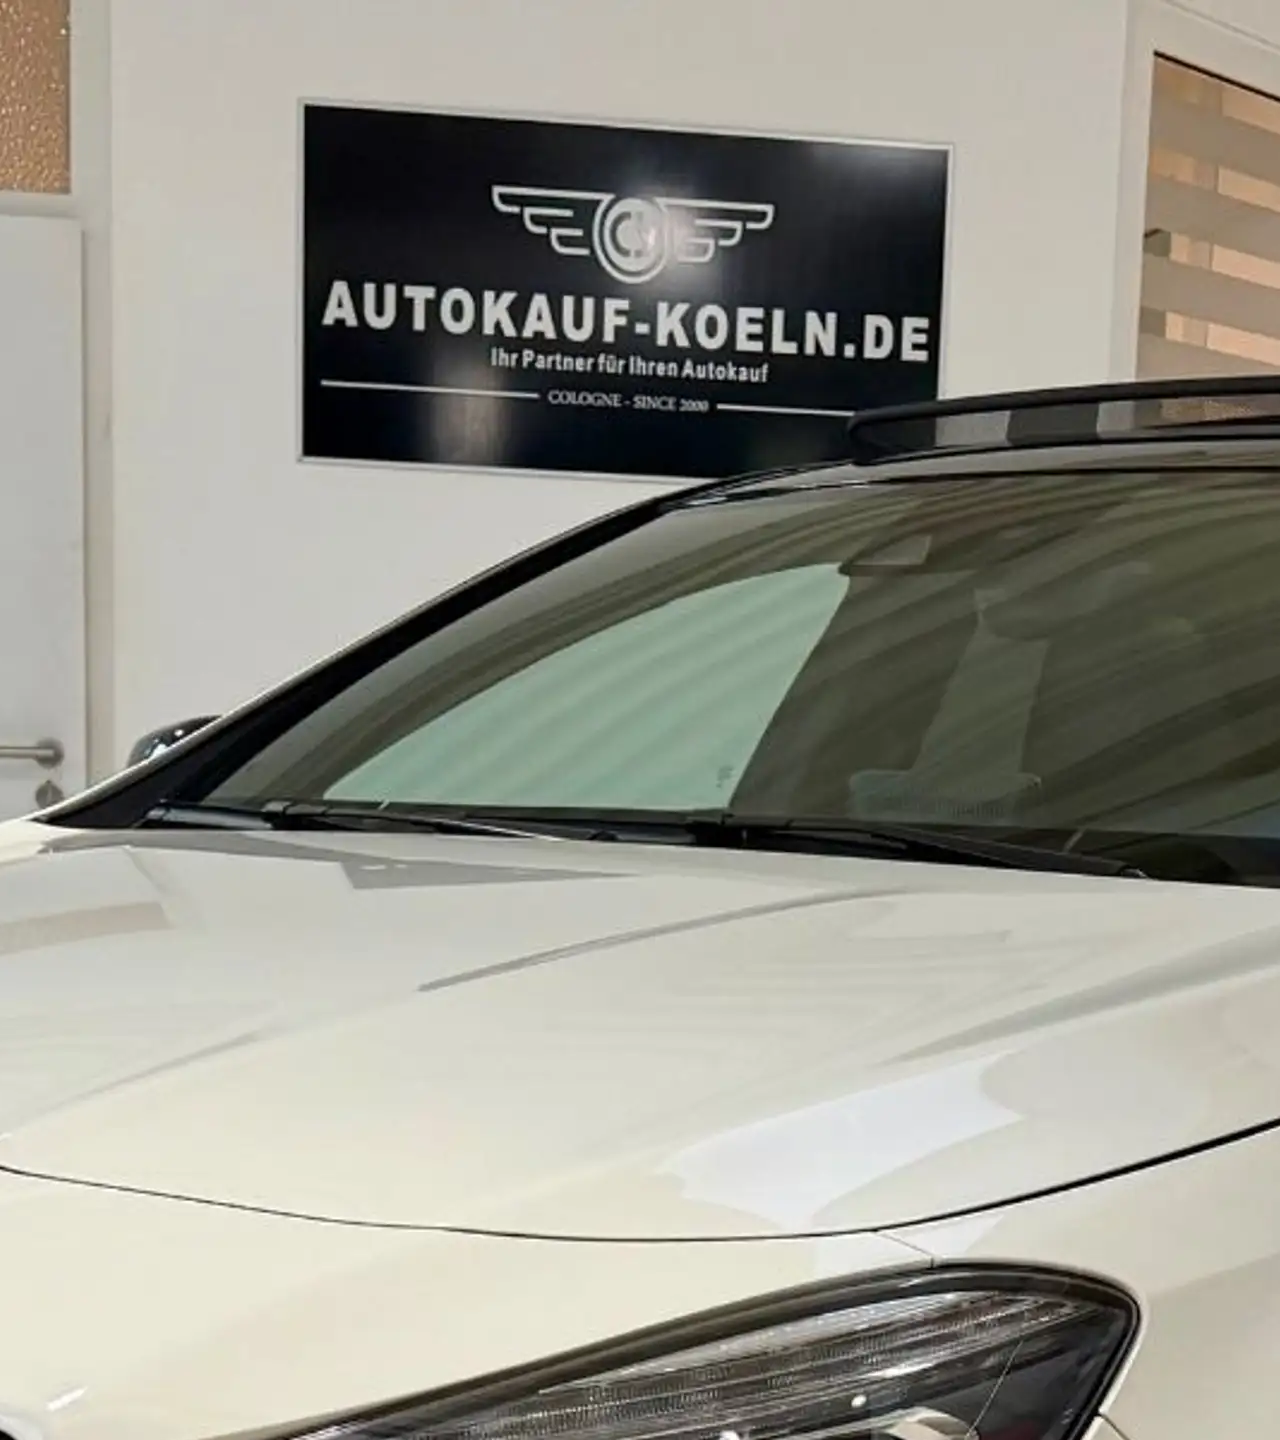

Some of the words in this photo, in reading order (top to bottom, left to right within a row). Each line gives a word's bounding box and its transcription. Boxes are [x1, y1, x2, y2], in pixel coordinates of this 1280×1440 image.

[322, 279, 930, 363] AUTOKAUF-KOELN.DE
[490, 347, 519, 369] Ihr
[522, 350, 593, 373] Partner
[597, 352, 624, 375] für
[628, 354, 678, 378] Ihren
[681, 358, 769, 383] Autokauf
[547, 388, 623, 408] COLOGNE
[632, 393, 677, 411] SINCE
